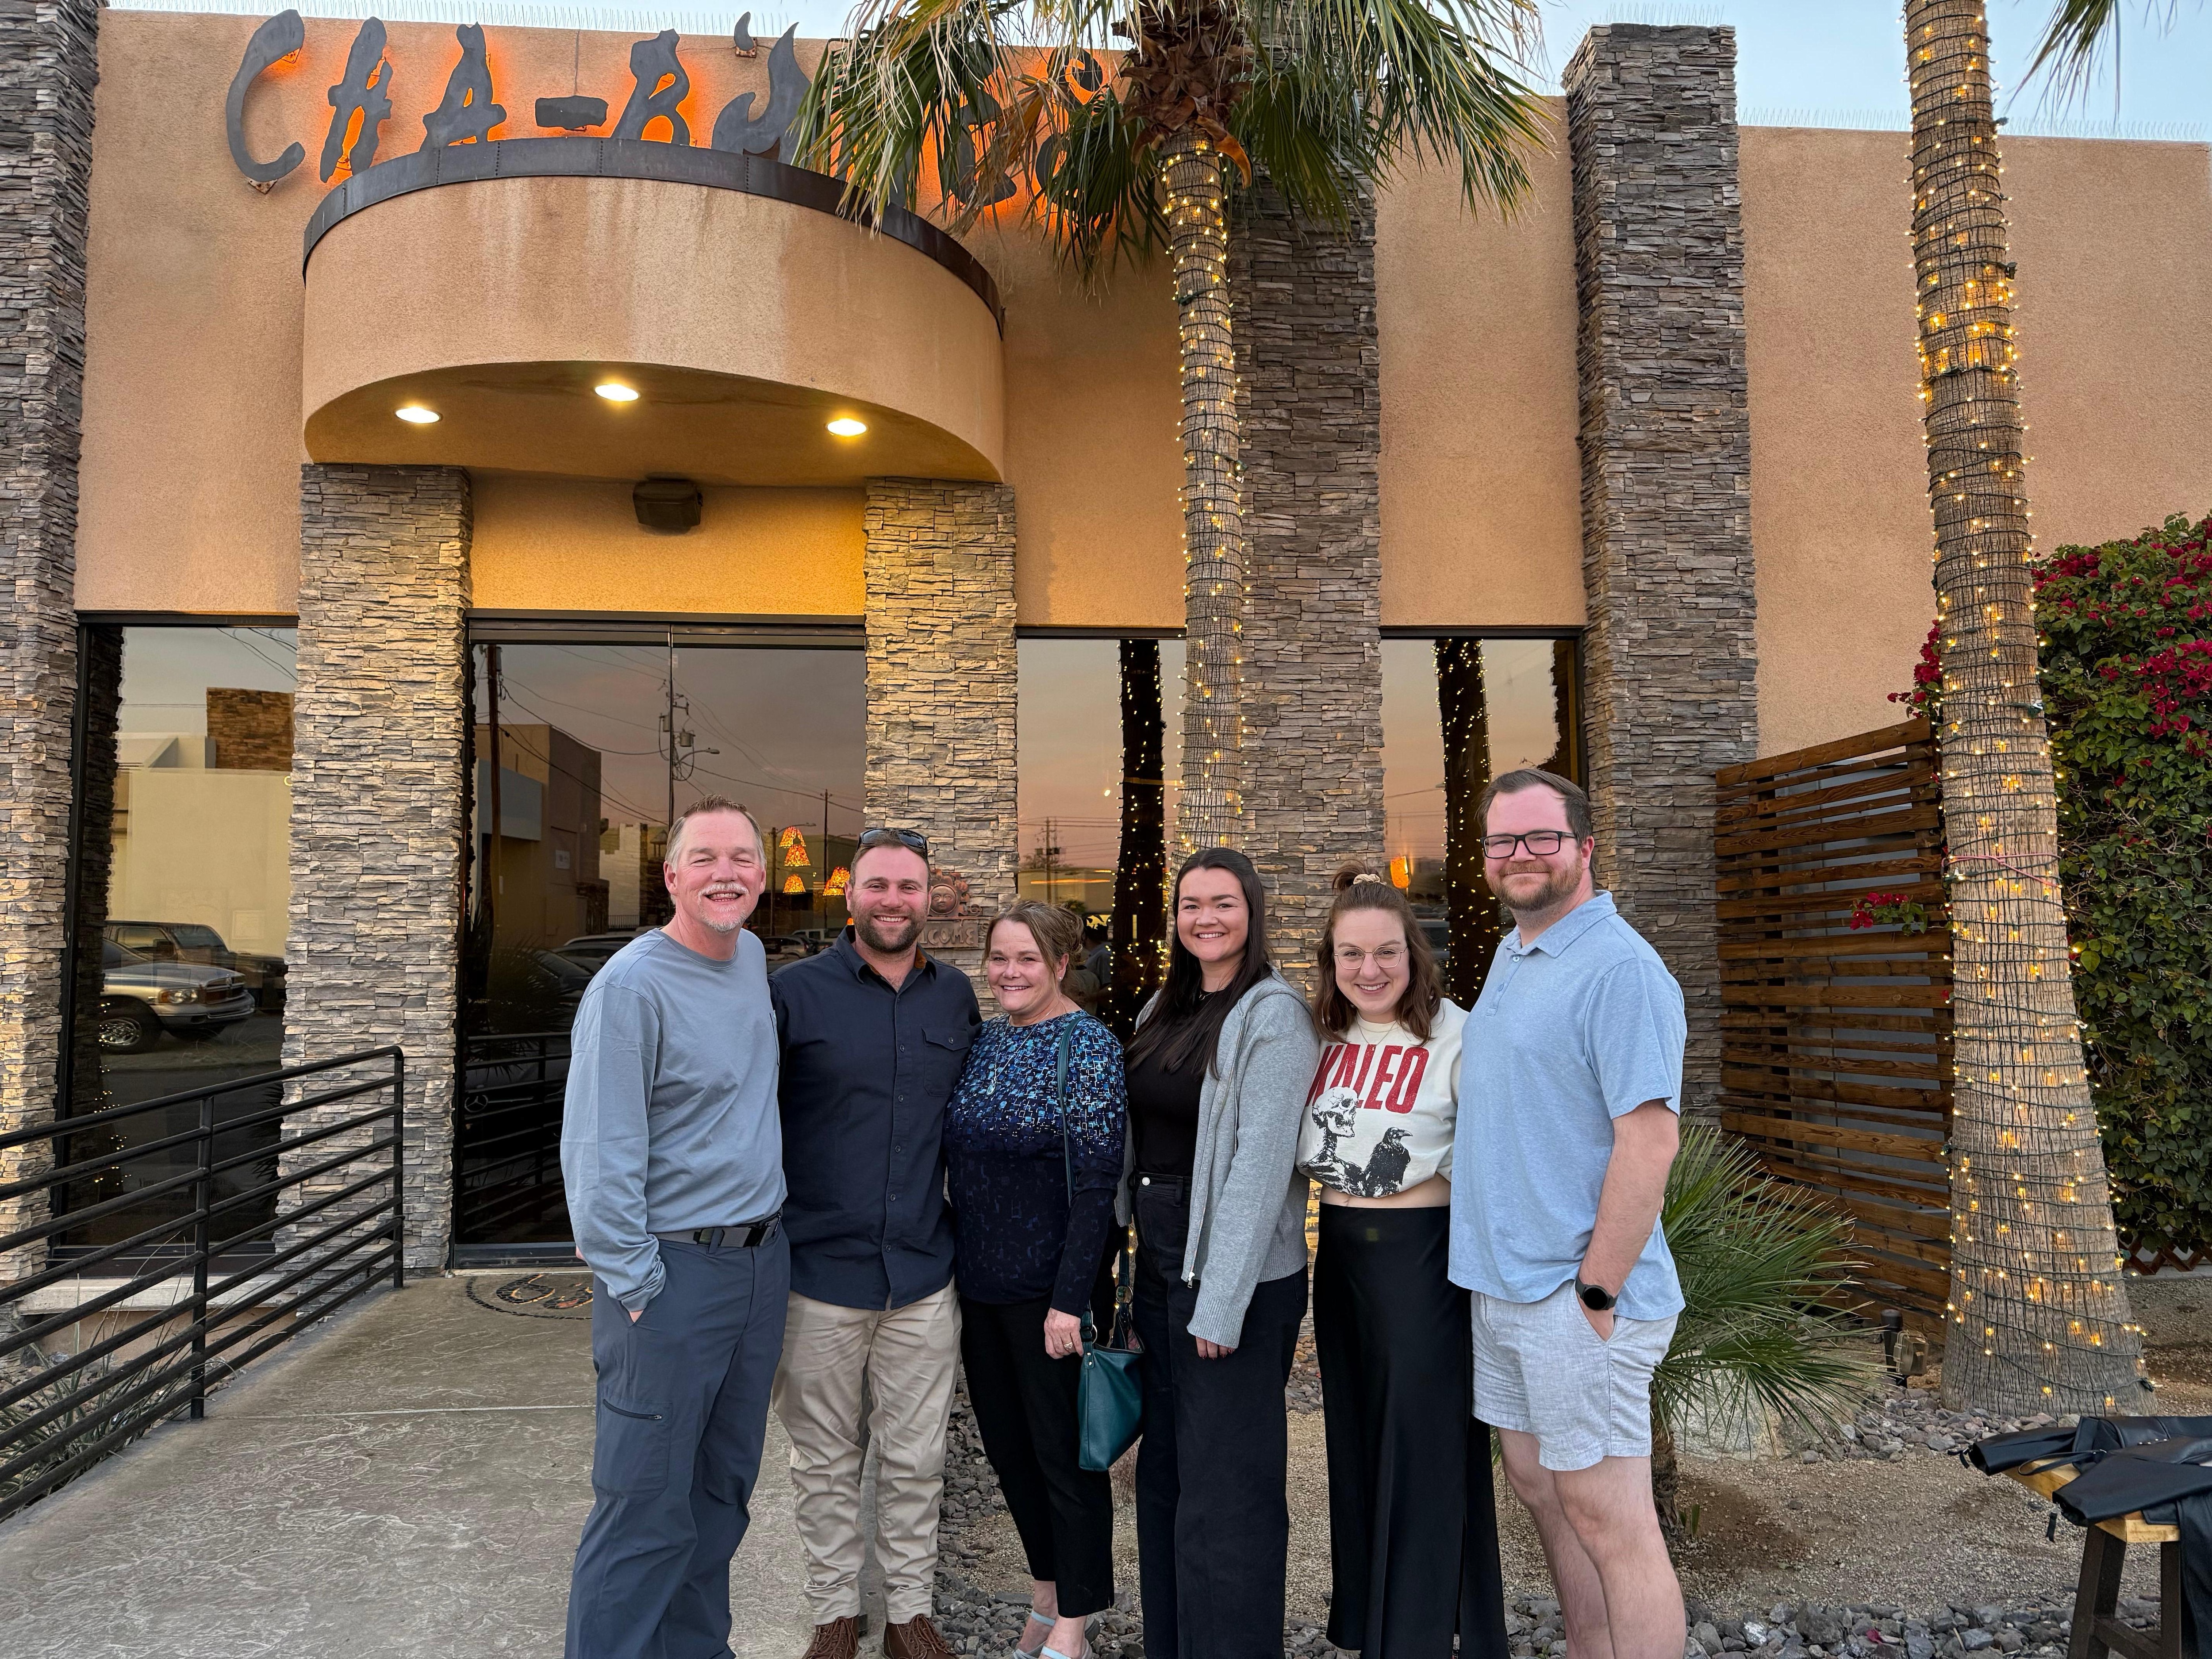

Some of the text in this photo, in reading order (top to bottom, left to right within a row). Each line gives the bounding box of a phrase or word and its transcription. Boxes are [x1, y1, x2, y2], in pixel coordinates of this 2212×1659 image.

[226, 9, 1103, 222] CHA-BES
[918, 928, 974, 945] LCOME
[1306, 1043, 1429, 1114] KALEO
